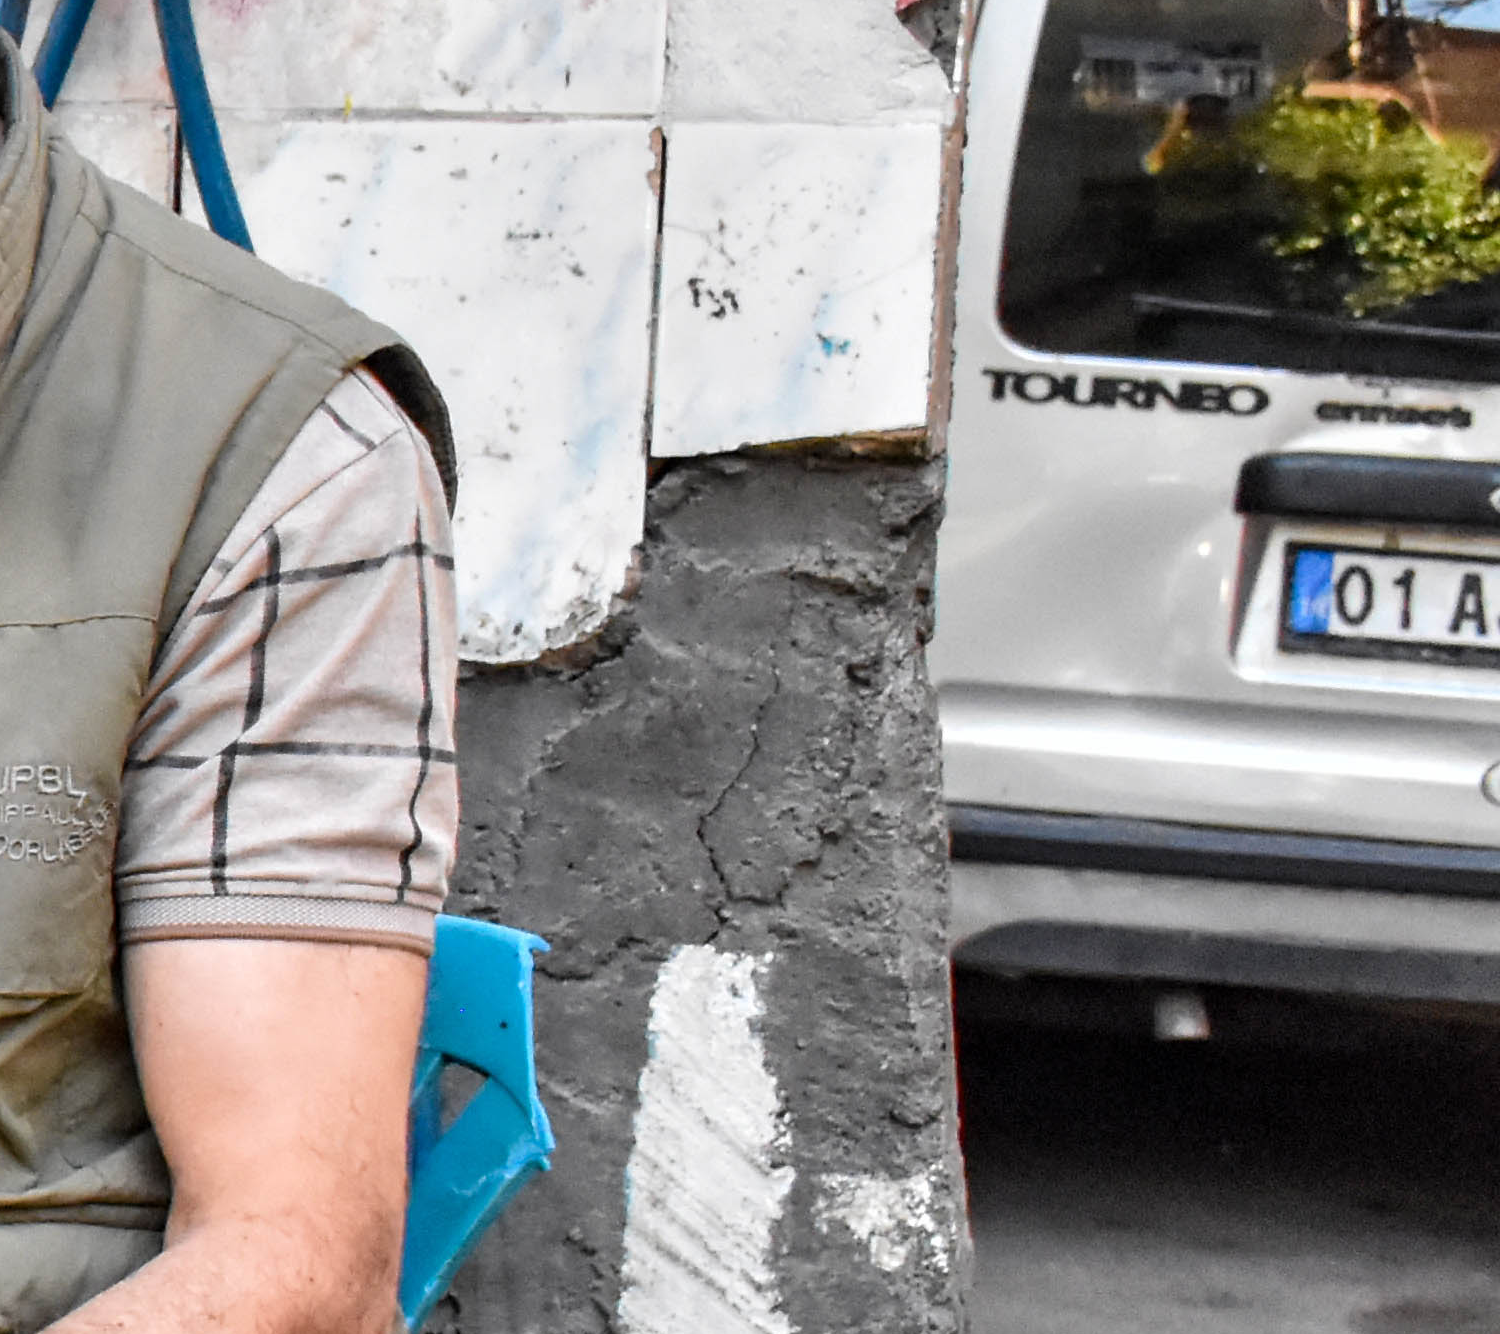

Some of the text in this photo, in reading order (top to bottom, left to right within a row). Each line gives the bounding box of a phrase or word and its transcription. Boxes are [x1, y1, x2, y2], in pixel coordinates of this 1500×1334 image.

[983, 368, 1271, 417] TOURNEO
[1336, 565, 1416, 631] 01
[1448, 572, 1500, 636] A
